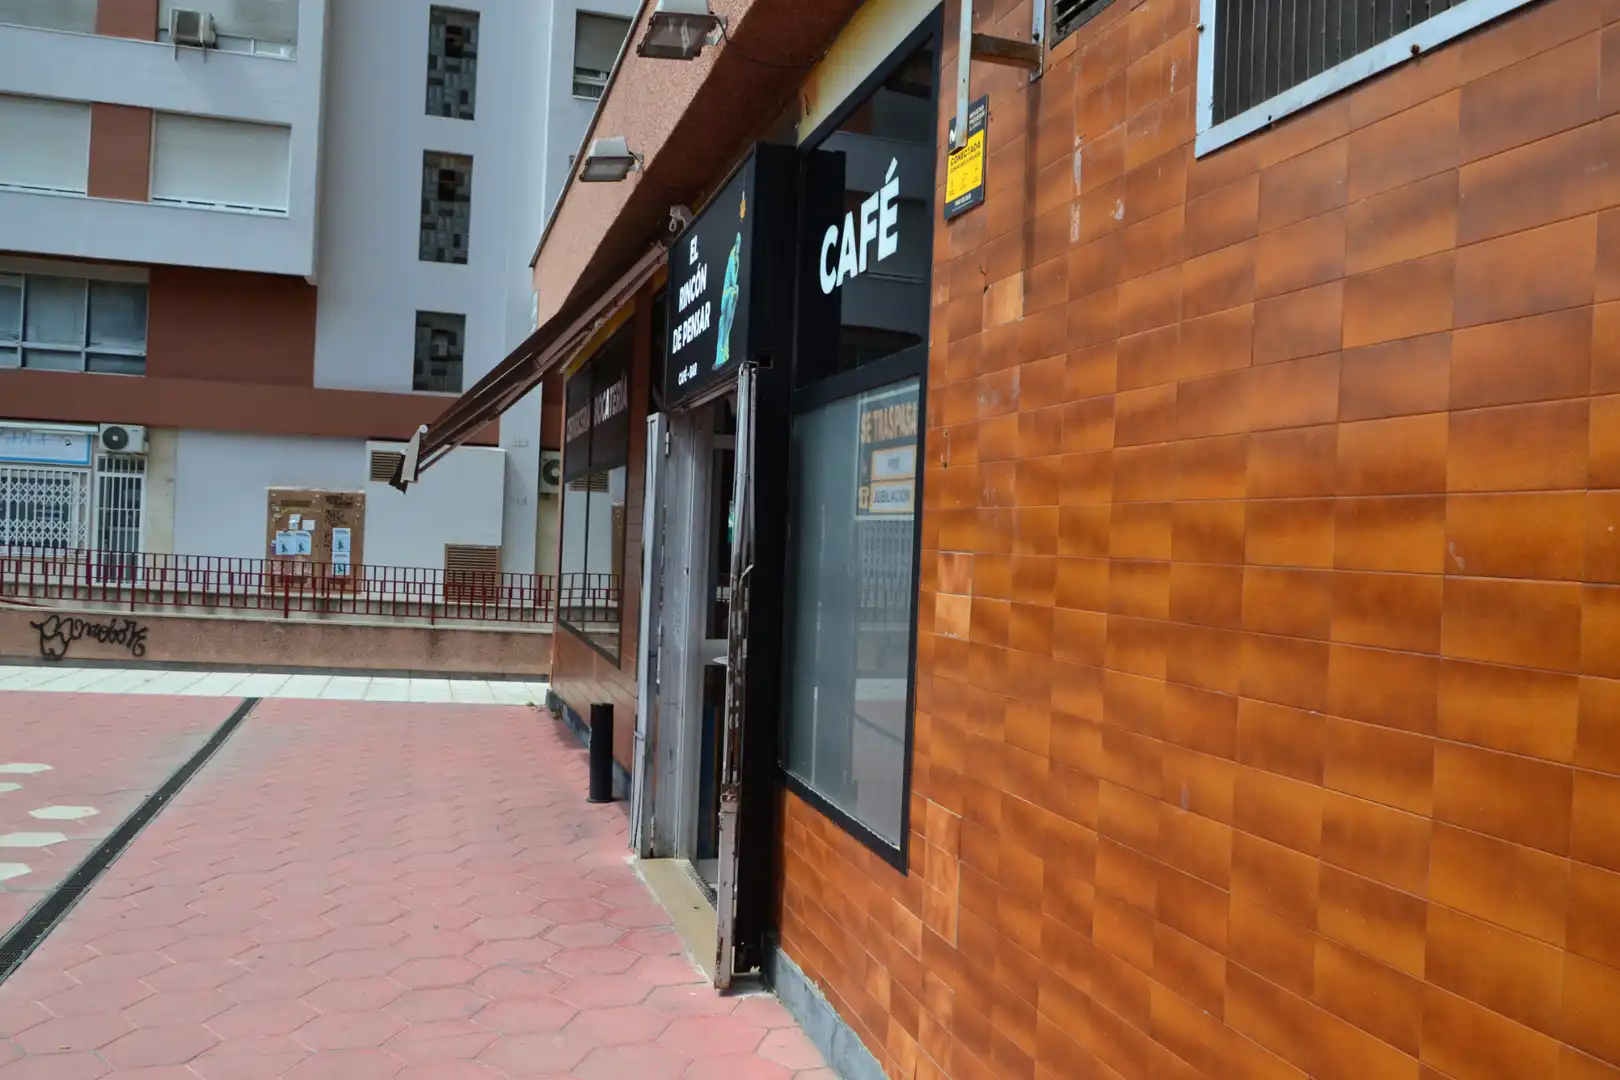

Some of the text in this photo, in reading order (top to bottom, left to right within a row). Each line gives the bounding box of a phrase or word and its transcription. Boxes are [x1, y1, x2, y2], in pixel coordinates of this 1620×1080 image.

[950, 141, 981, 166] CONECTADA
[820, 157, 899, 294] CAFÉ
[689, 235, 699, 265] EL
[678, 262, 708, 312] RINCÓN
[672, 301, 711, 354] DE PENSAR
[861, 401, 917, 445] SE TRASPASA
